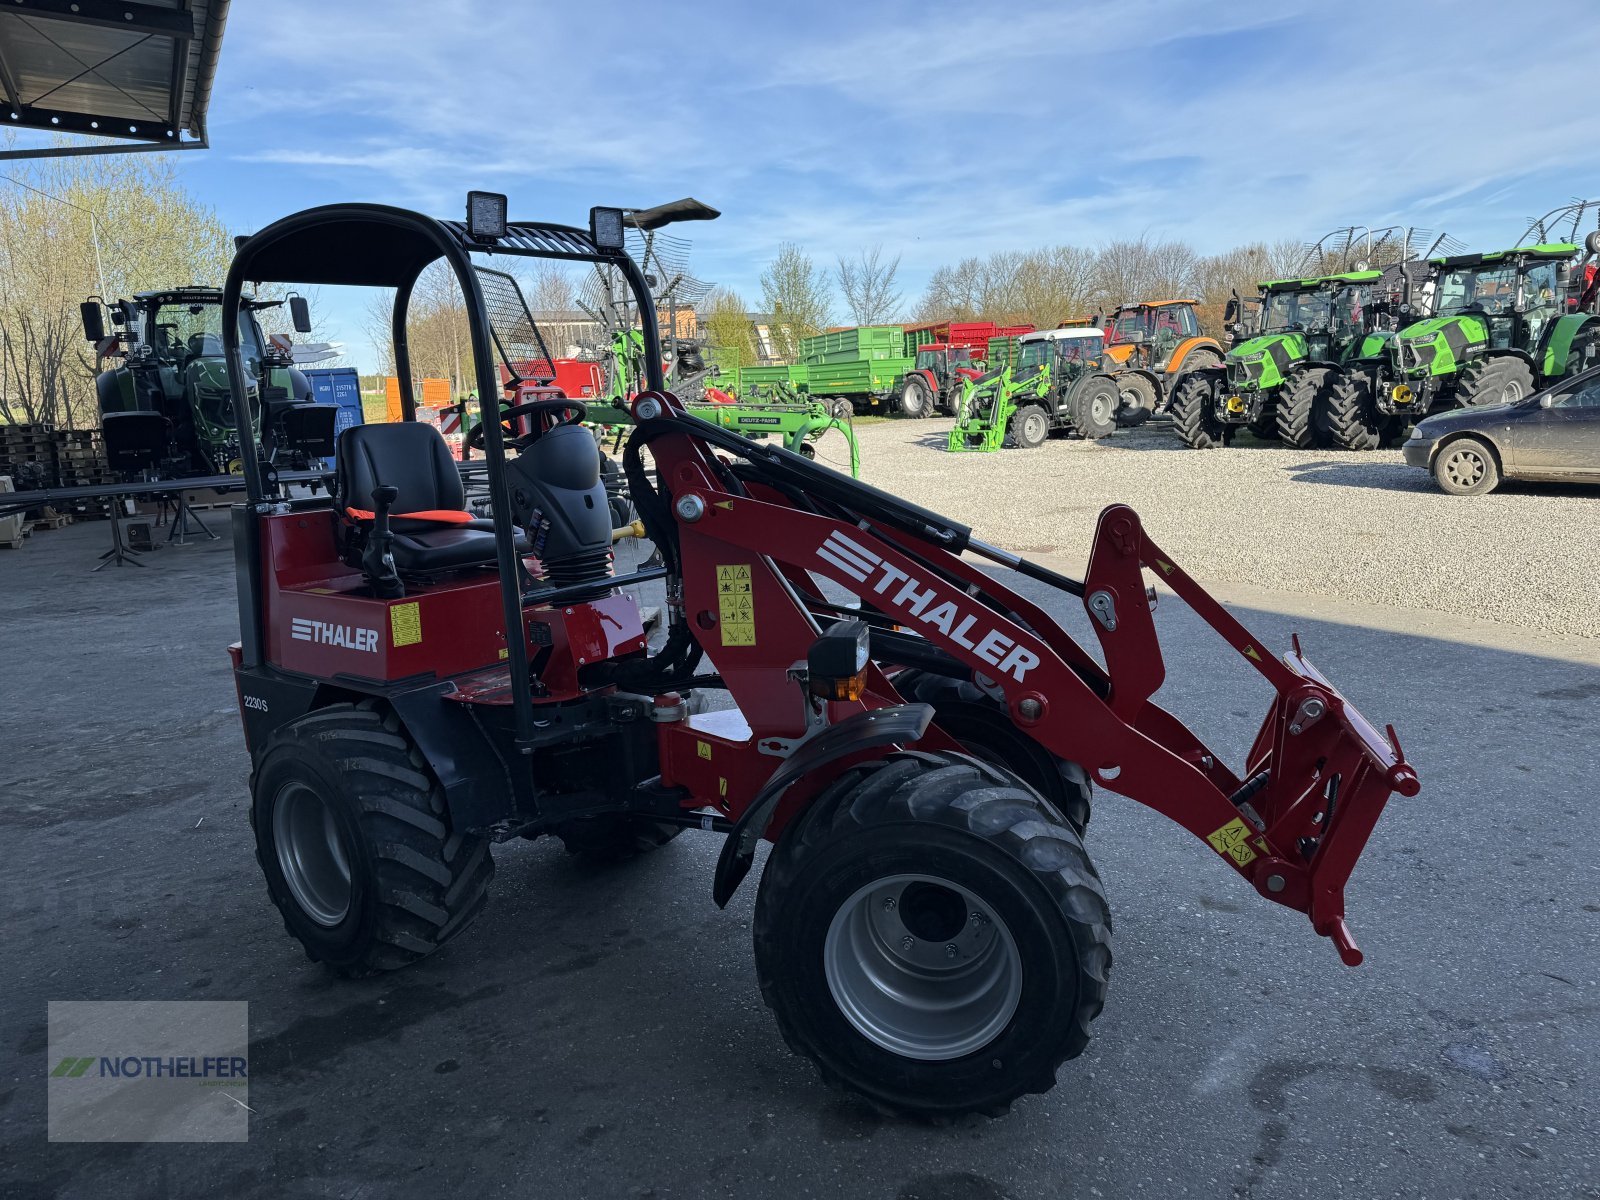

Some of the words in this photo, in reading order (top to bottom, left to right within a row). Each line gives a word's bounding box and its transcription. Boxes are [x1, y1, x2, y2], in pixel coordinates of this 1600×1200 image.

[311, 620, 379, 653] THALER
[873, 561, 1040, 683] THALER
[243, 695, 262, 710] 2230
[261, 699, 268, 712] S
